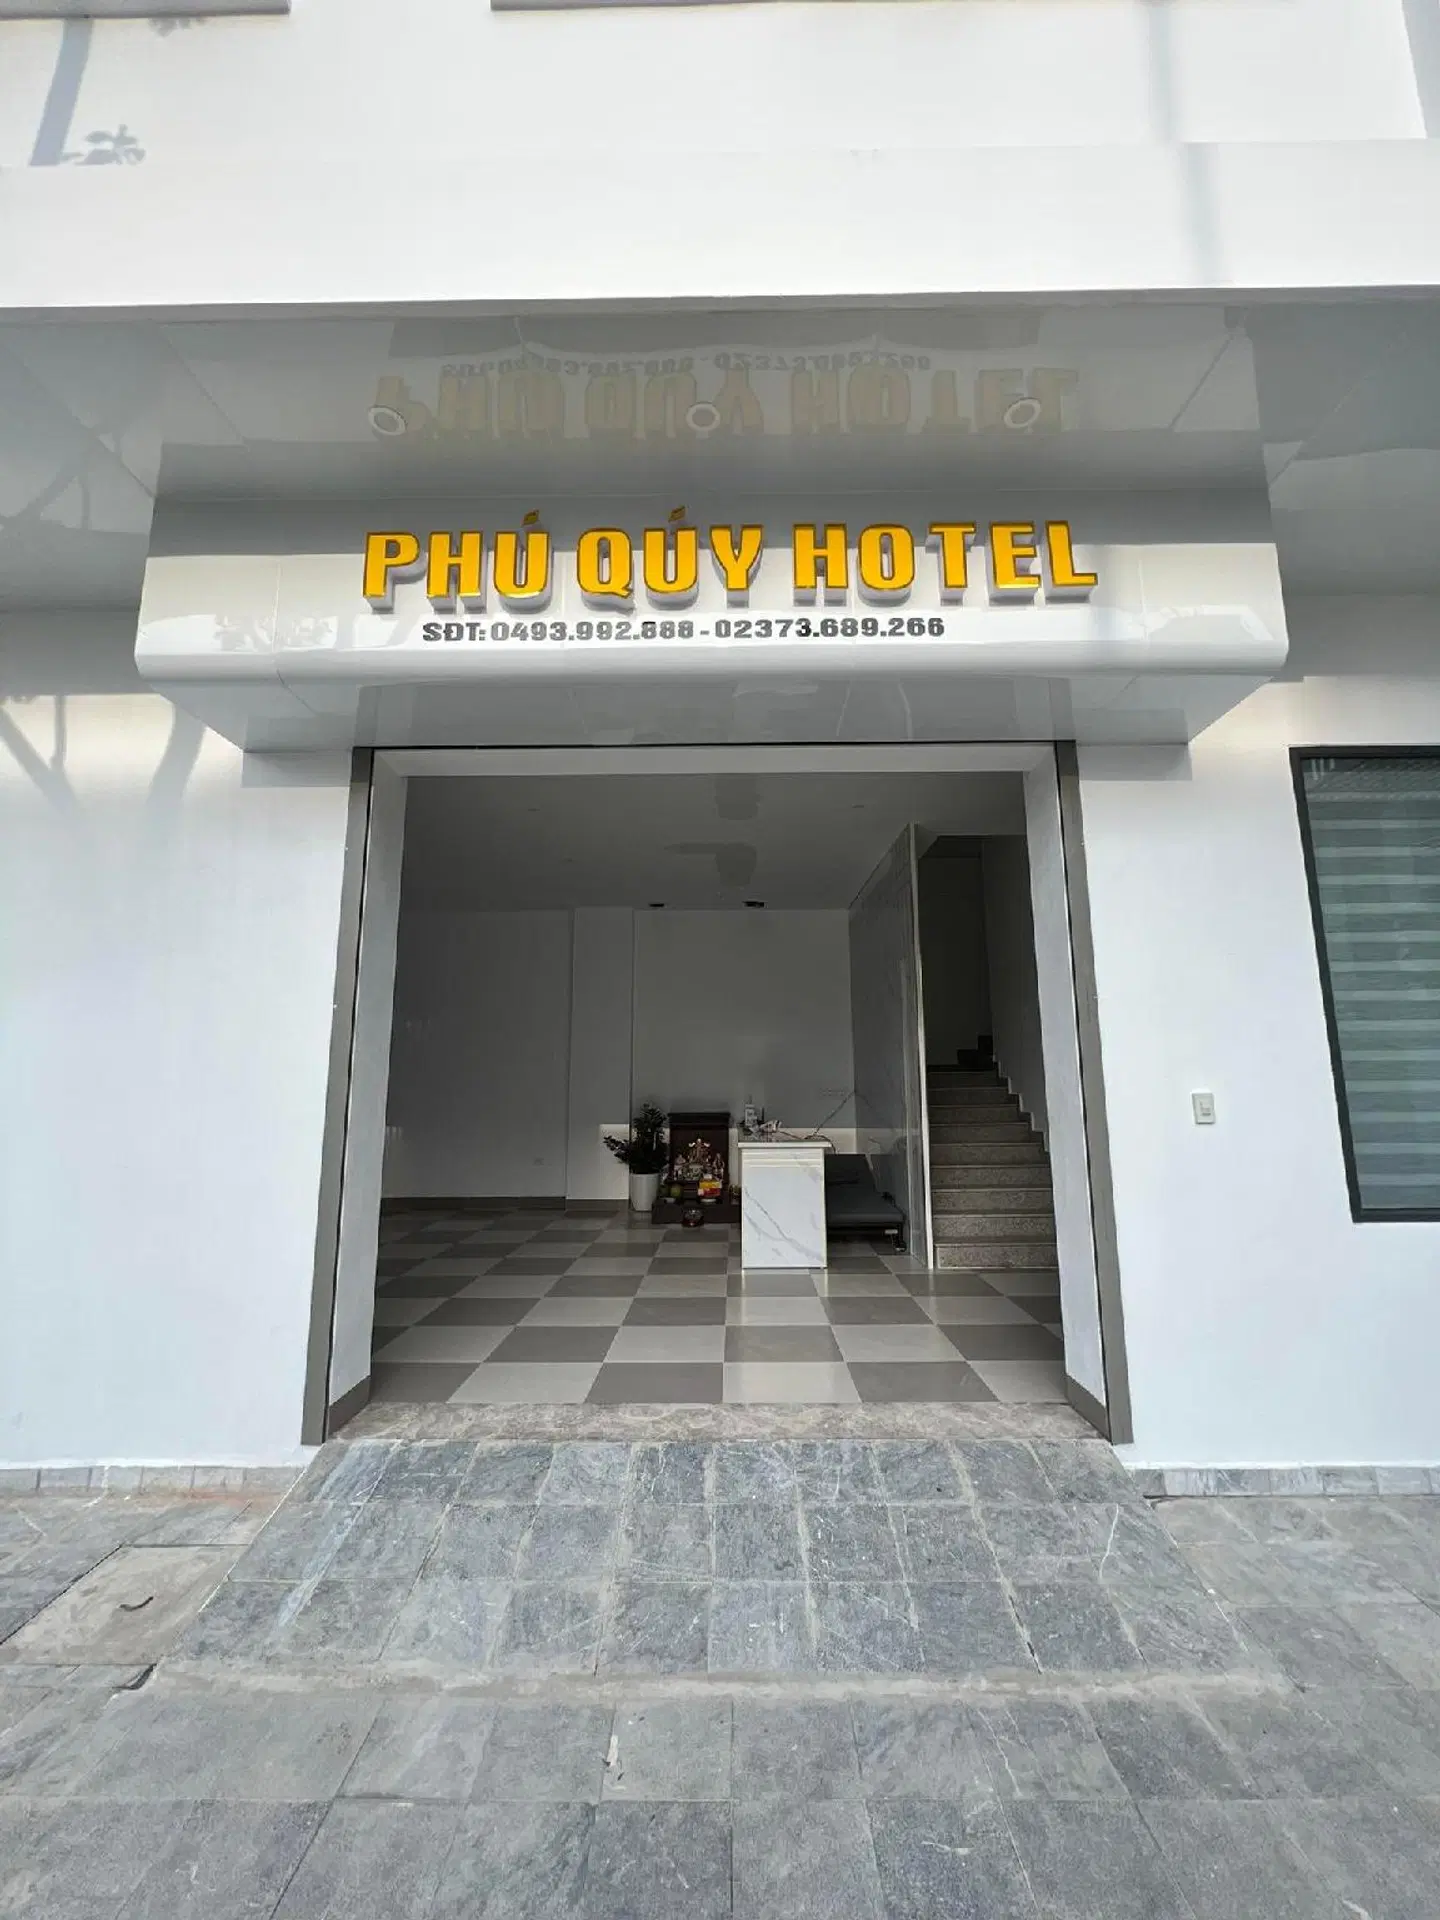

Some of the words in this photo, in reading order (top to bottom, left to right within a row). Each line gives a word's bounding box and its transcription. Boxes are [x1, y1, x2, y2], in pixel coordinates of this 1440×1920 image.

[362, 509, 550, 601] PHÚ
[576, 505, 764, 600] QÚY
[792, 519, 1099, 592] HOTEL
